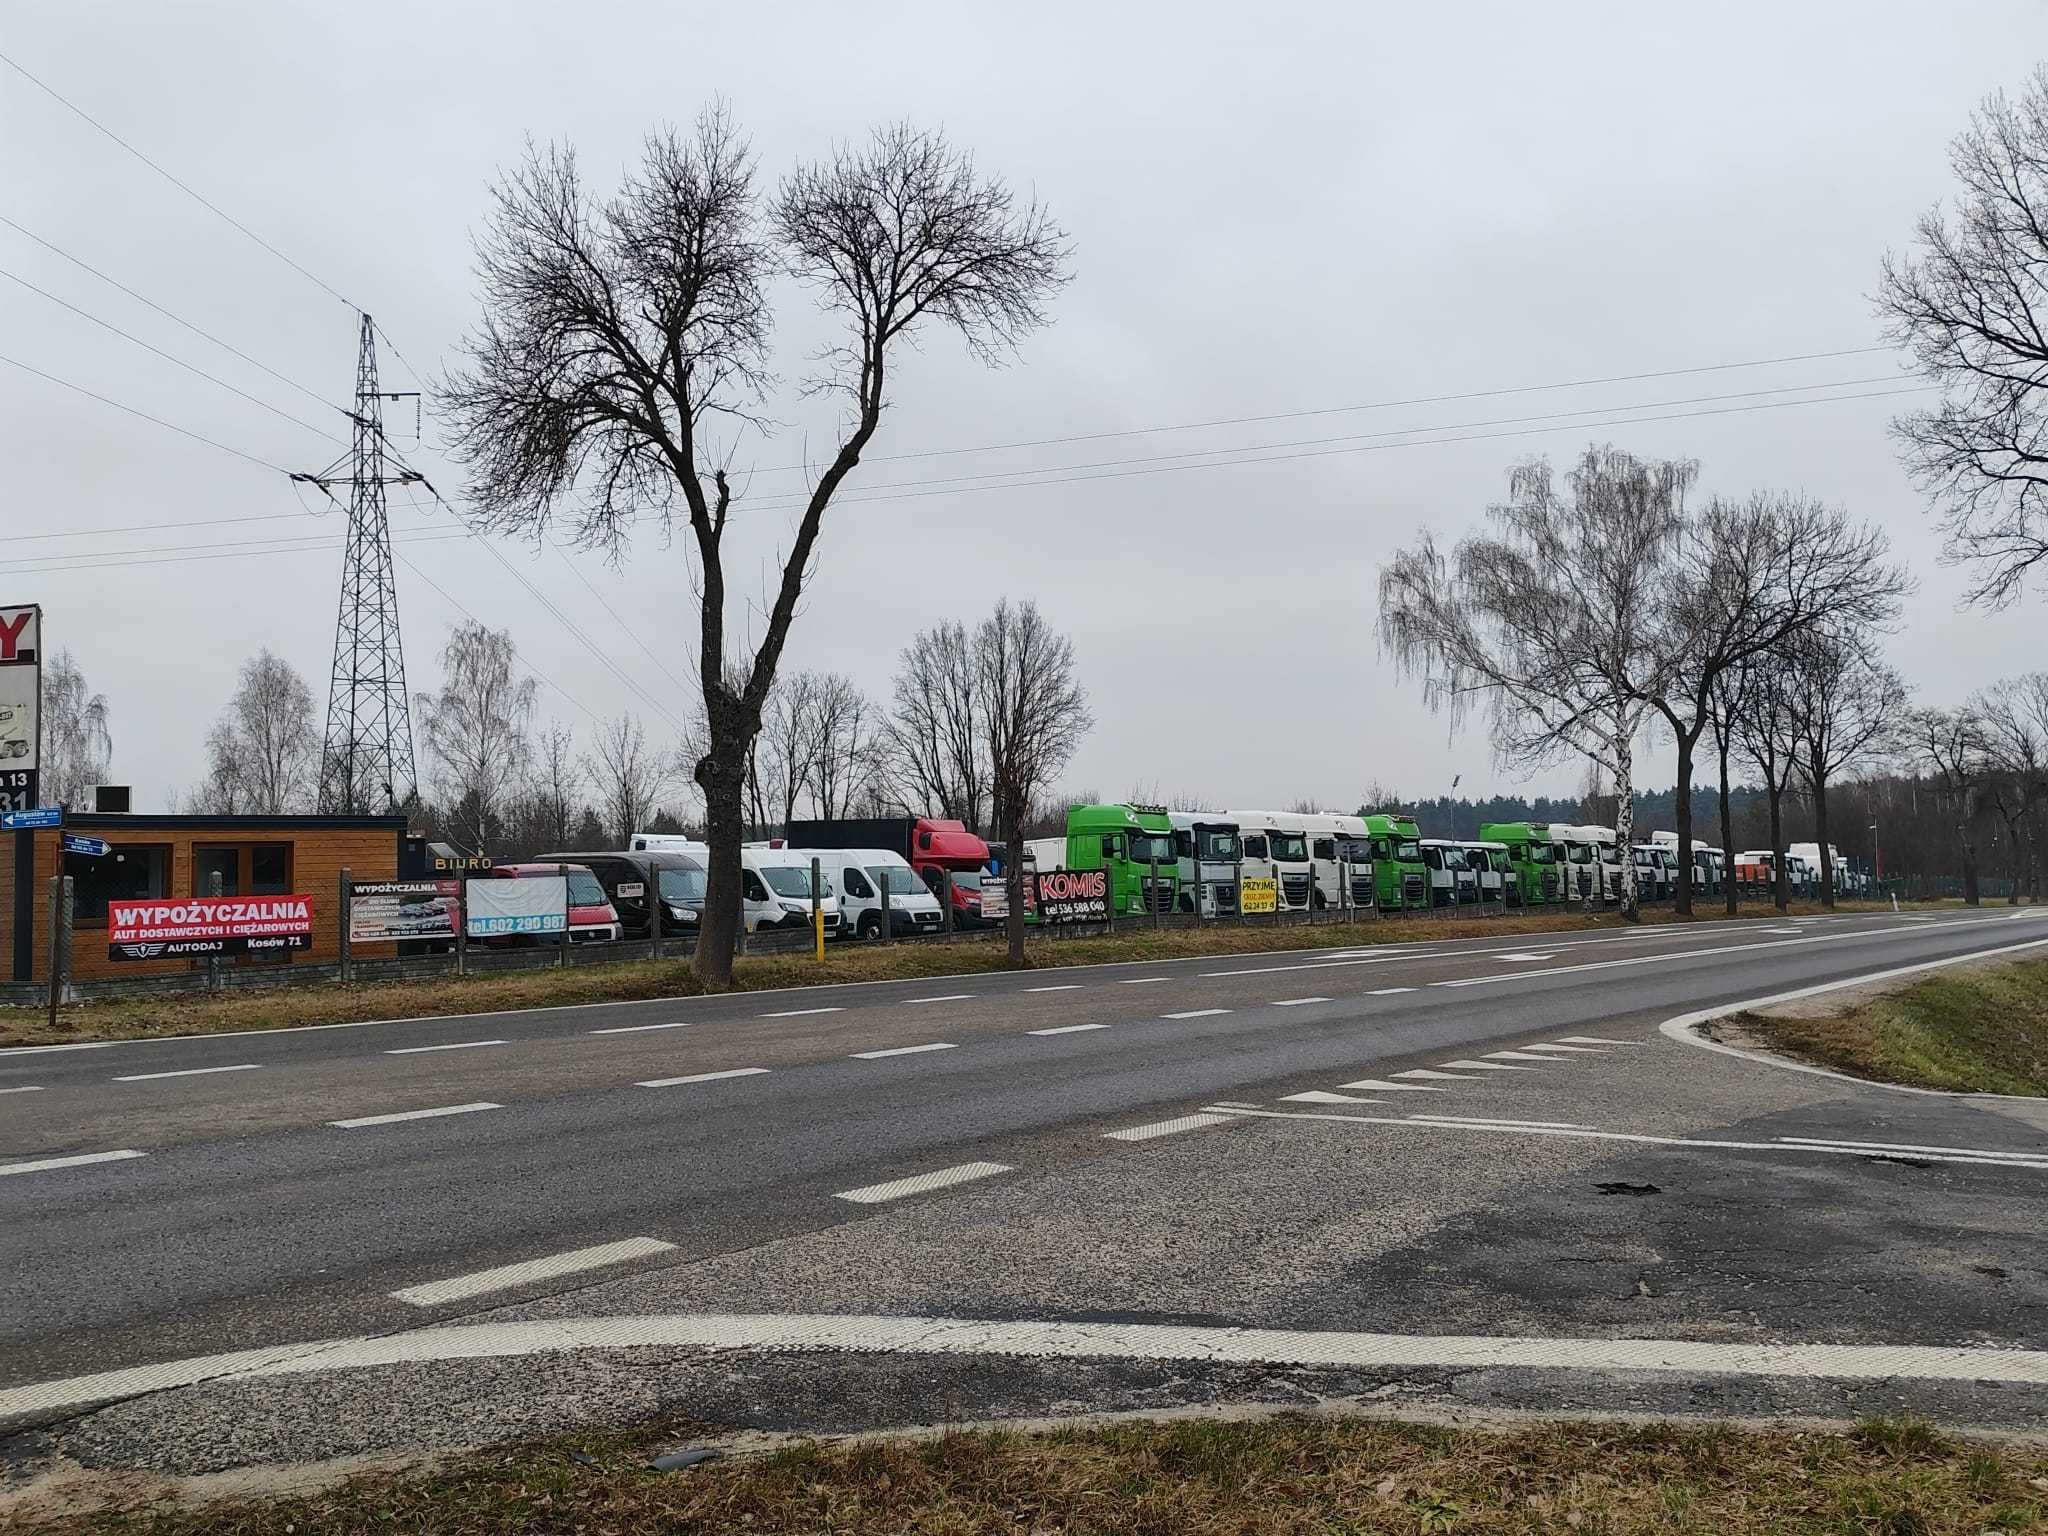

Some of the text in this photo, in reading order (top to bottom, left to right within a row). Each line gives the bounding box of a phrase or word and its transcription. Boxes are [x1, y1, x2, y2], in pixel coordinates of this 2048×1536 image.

[0, 612, 33, 659] Y
[10, 772, 28, 786] 13
[435, 858, 492, 870] BIURO
[354, 883, 438, 893] WYPOŻYCZALNIA
[1039, 872, 1106, 901] KOMIS
[114, 902, 309, 926] WYPOŻYCZALNIA
[1045, 904, 1058, 915] tel
[1059, 903, 1073, 914] 536
[1073, 902, 1089, 913] 588
[516, 917, 541, 930] 290
[543, 916, 566, 929] 987
[113, 922, 309, 940] AUT DOSTAWCZYCH I CIĘŻAROWYCH
[167, 937, 302, 953] AUTODAJ Kosów 71
